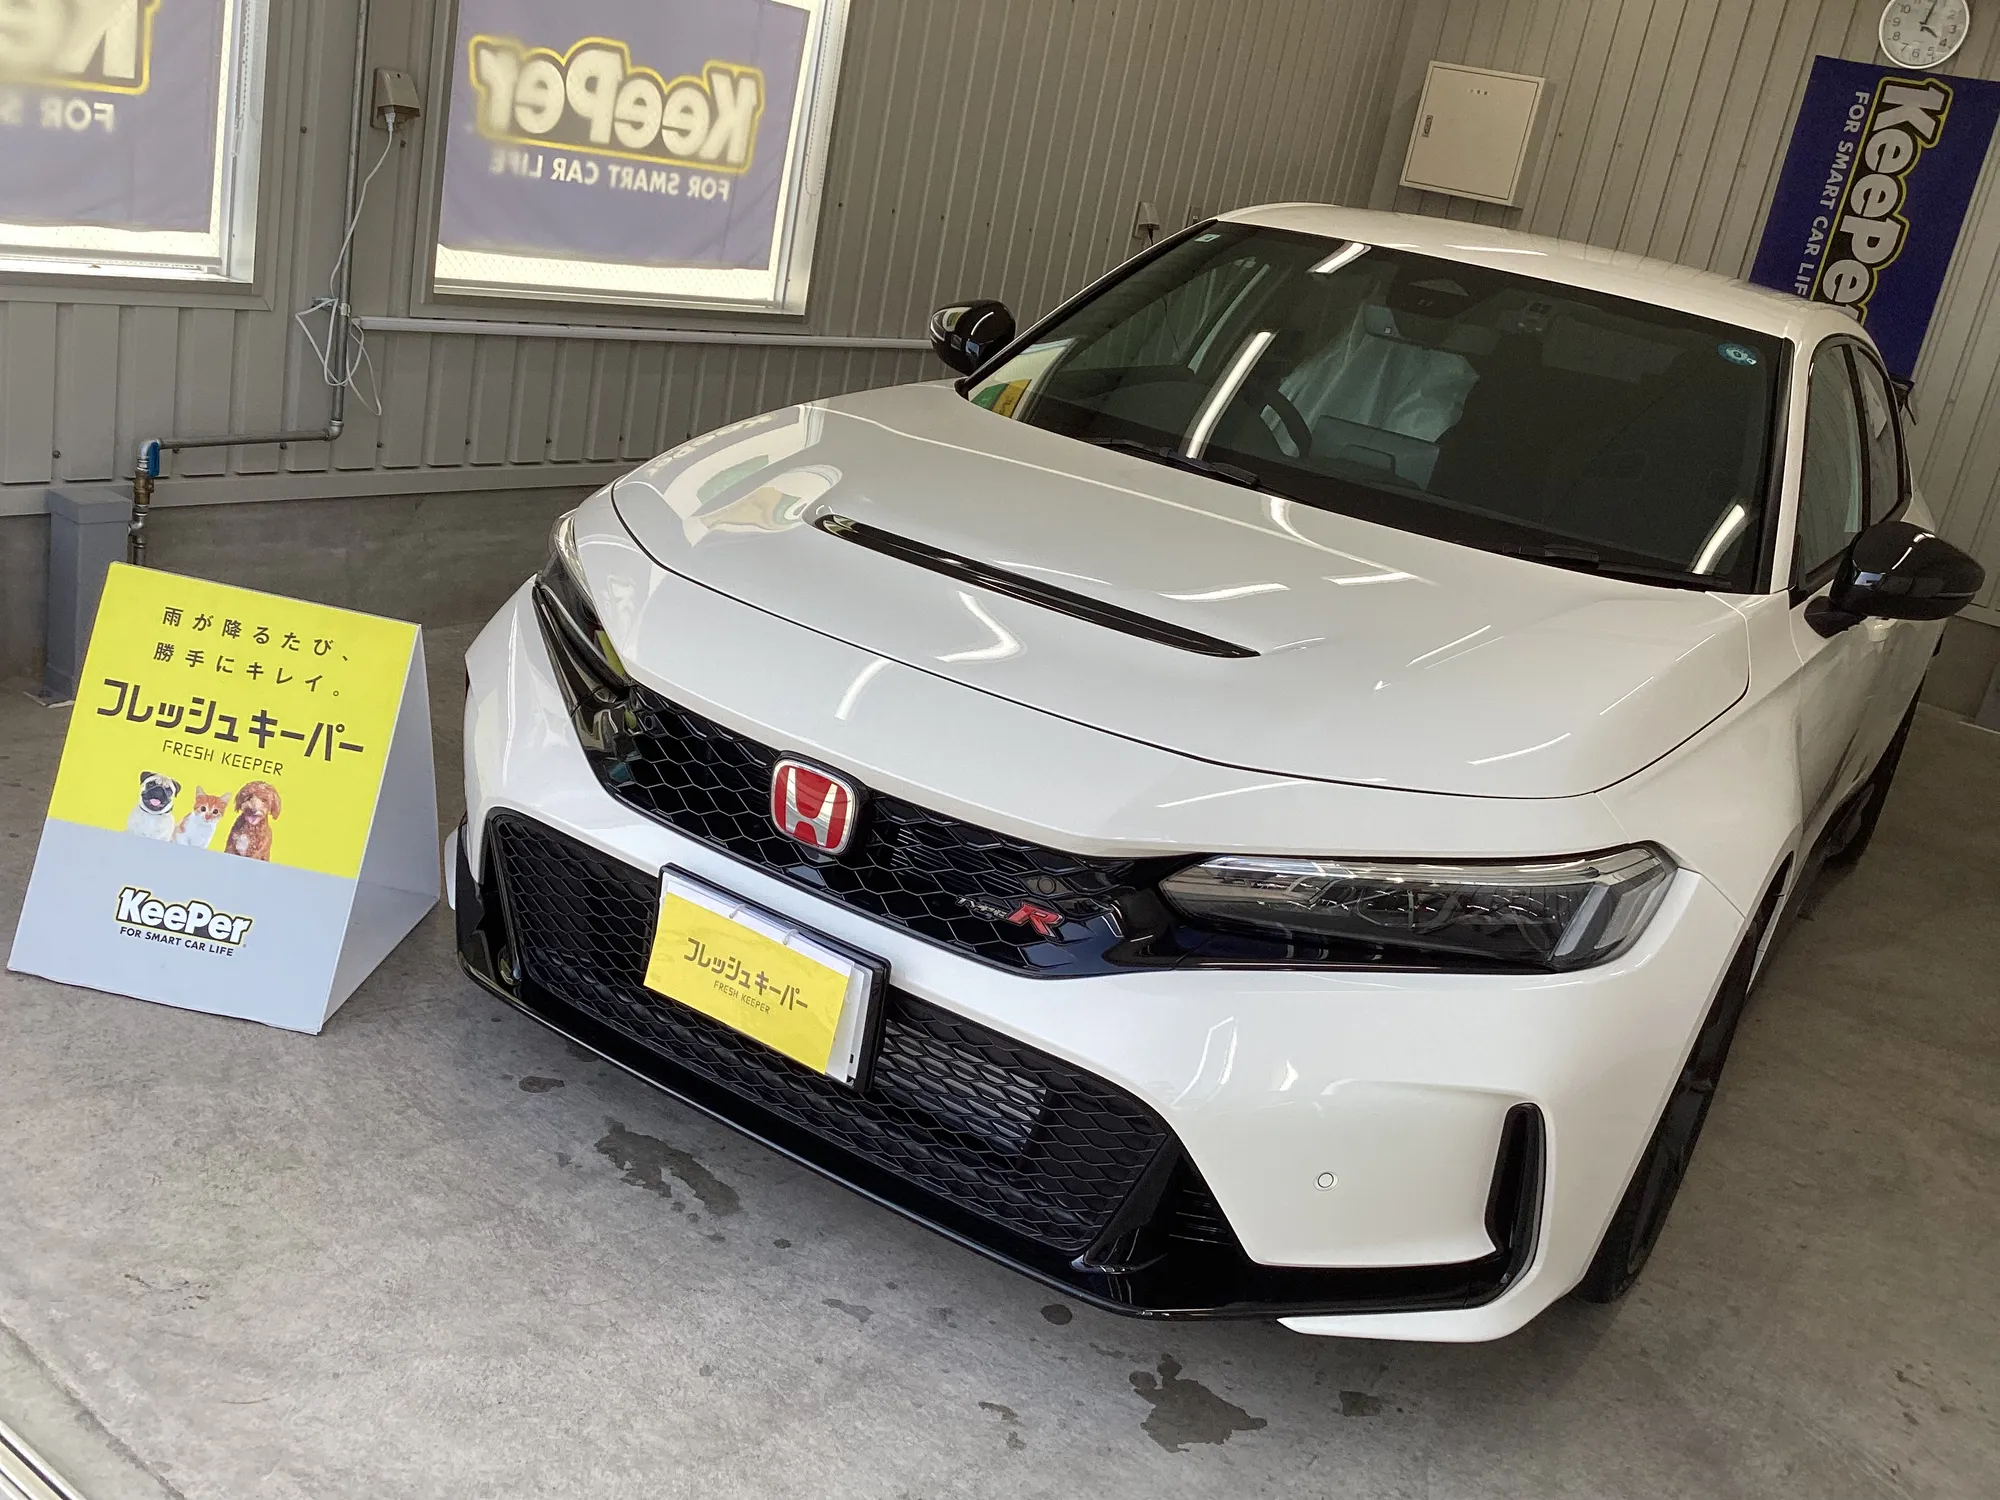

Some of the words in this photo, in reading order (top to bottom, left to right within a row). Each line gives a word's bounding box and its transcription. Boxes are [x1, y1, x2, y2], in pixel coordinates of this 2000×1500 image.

[1844, 90, 1871, 134] FOR
[1819, 140, 1854, 211] SMART
[1802, 214, 1829, 257] CAR
[1793, 262, 1815, 296] LIF
[161, 605, 349, 662] 雨が降るたび、
[153, 641, 340, 697] 勝手にキレイ。
[96, 677, 365, 762] フレッシュキーパー
[162, 739, 215, 762] FRESH
[221, 751, 284, 777] KEEPER
[116, 886, 253, 945] KeePer
[119, 926, 142, 938] FOR
[145, 931, 182, 946] SMART
[184, 939, 206, 951] CAR
[208, 944, 234, 957] LIFE
[683, 937, 808, 1011] フレッシュキーパー
[713, 980, 739, 999] FRESH
[740, 992, 772, 1015] KEEPER
